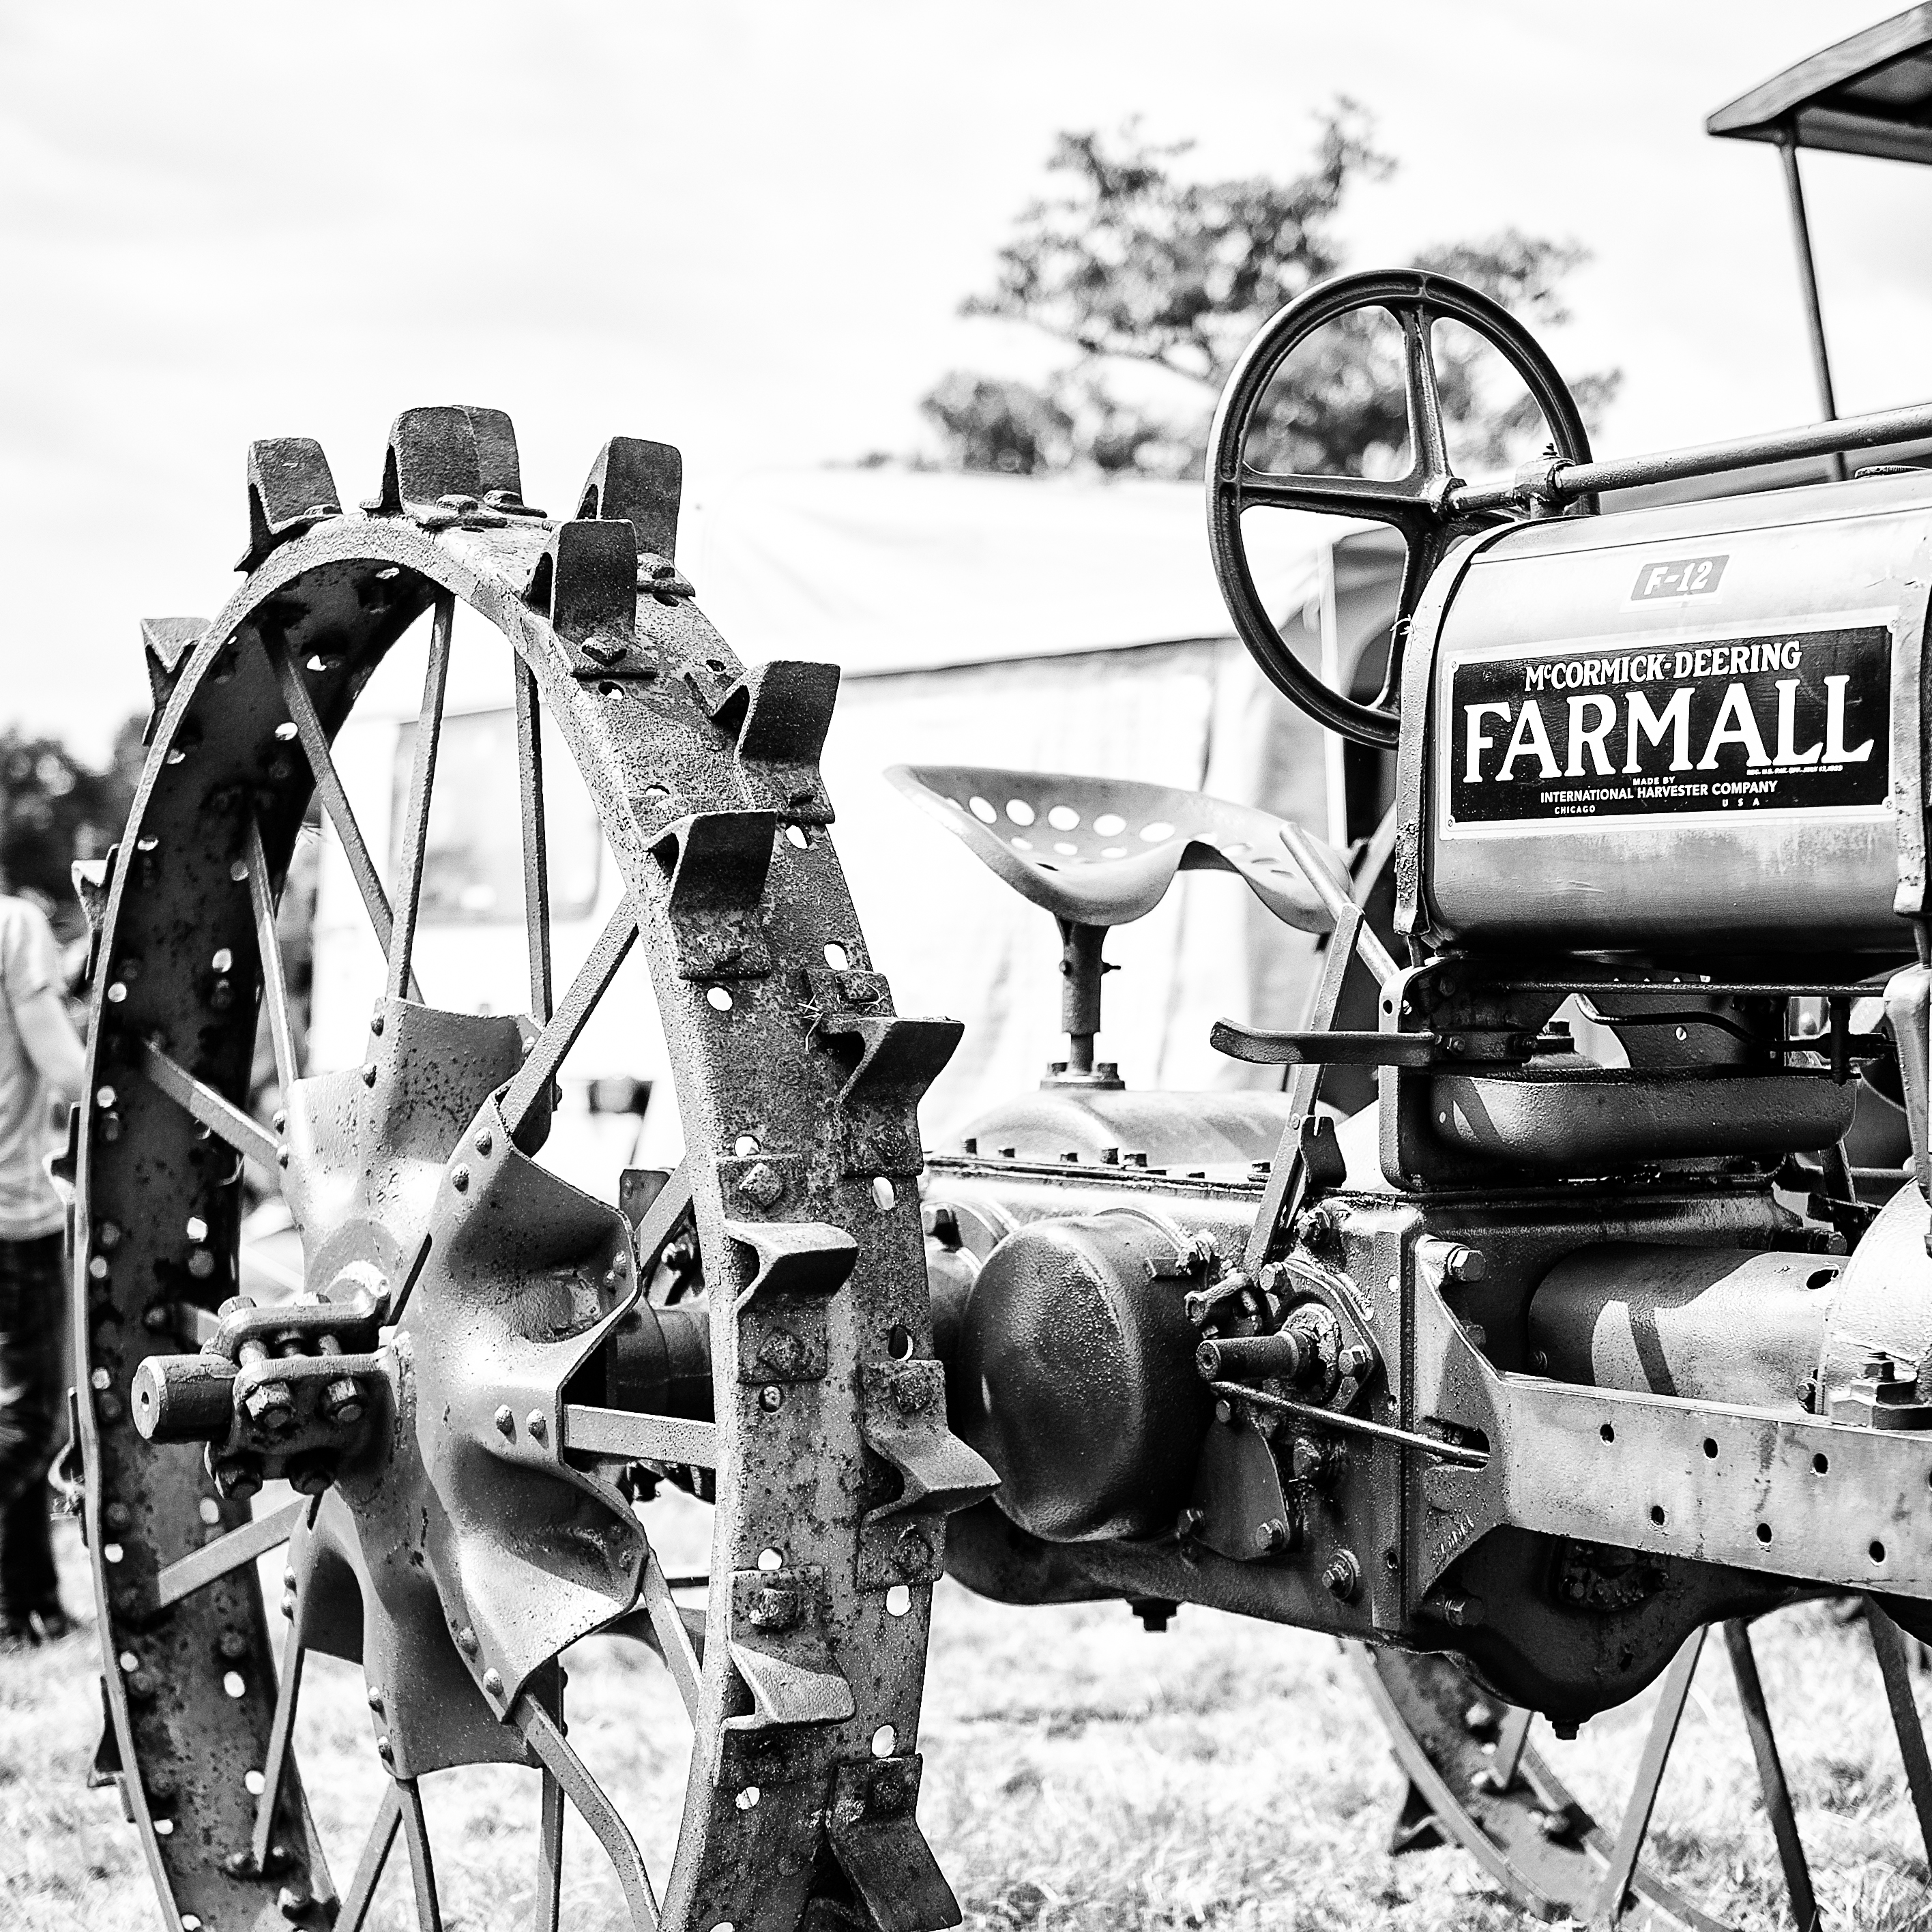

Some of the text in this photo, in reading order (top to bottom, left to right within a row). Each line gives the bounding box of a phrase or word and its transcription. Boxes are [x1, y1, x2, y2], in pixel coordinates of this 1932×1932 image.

[1643, 561, 1713, 596] F-12
[1463, 675, 1875, 783] FARMALL
[1540, 780, 1778, 803] INTERNATIONAL HARVESTER COMPANY
[1633, 776, 1675, 785] MADE BY
[1554, 805, 1596, 815] CHICAGO
